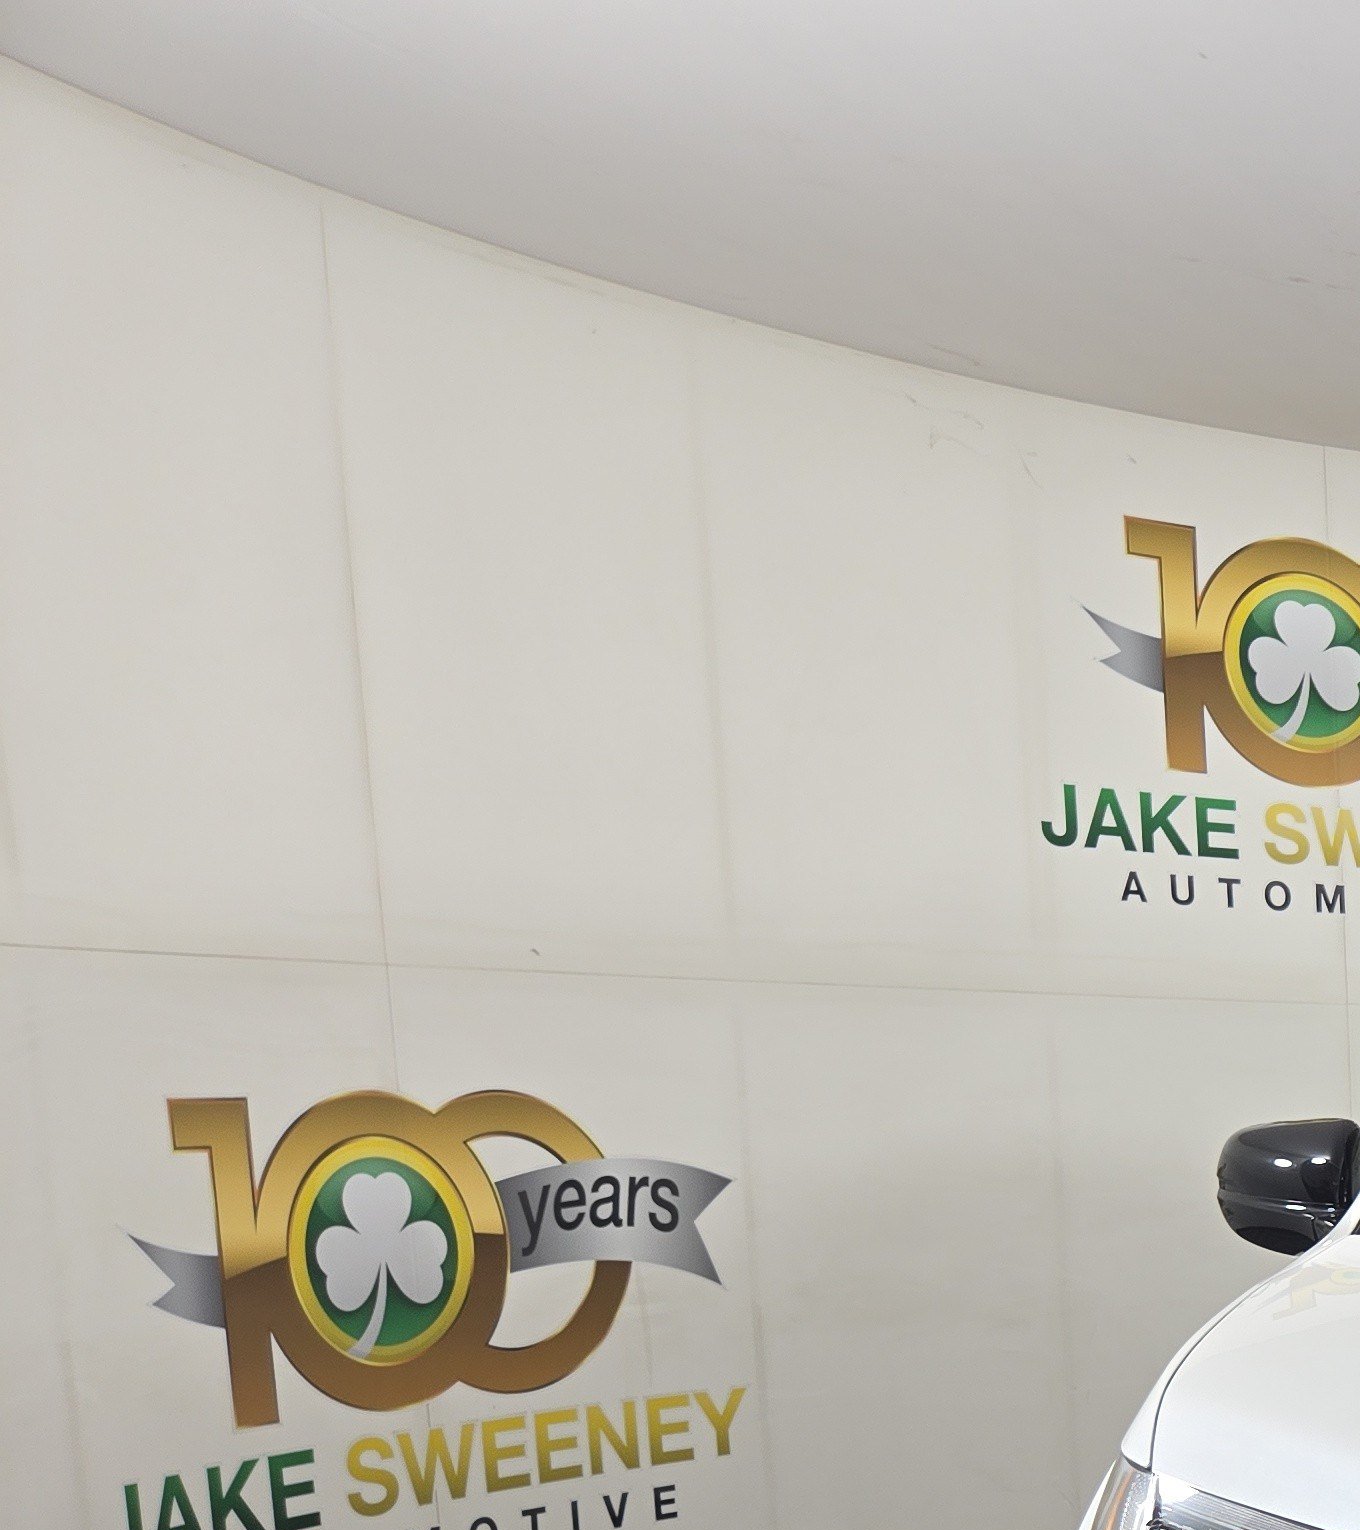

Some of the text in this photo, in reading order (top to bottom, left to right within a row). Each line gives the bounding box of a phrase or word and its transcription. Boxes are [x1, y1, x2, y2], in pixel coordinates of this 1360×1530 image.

[1041, 784, 1240, 860] JAKE
[166, 1089, 680, 1429] 100 years
[346, 1387, 746, 1517] SWEENEY
